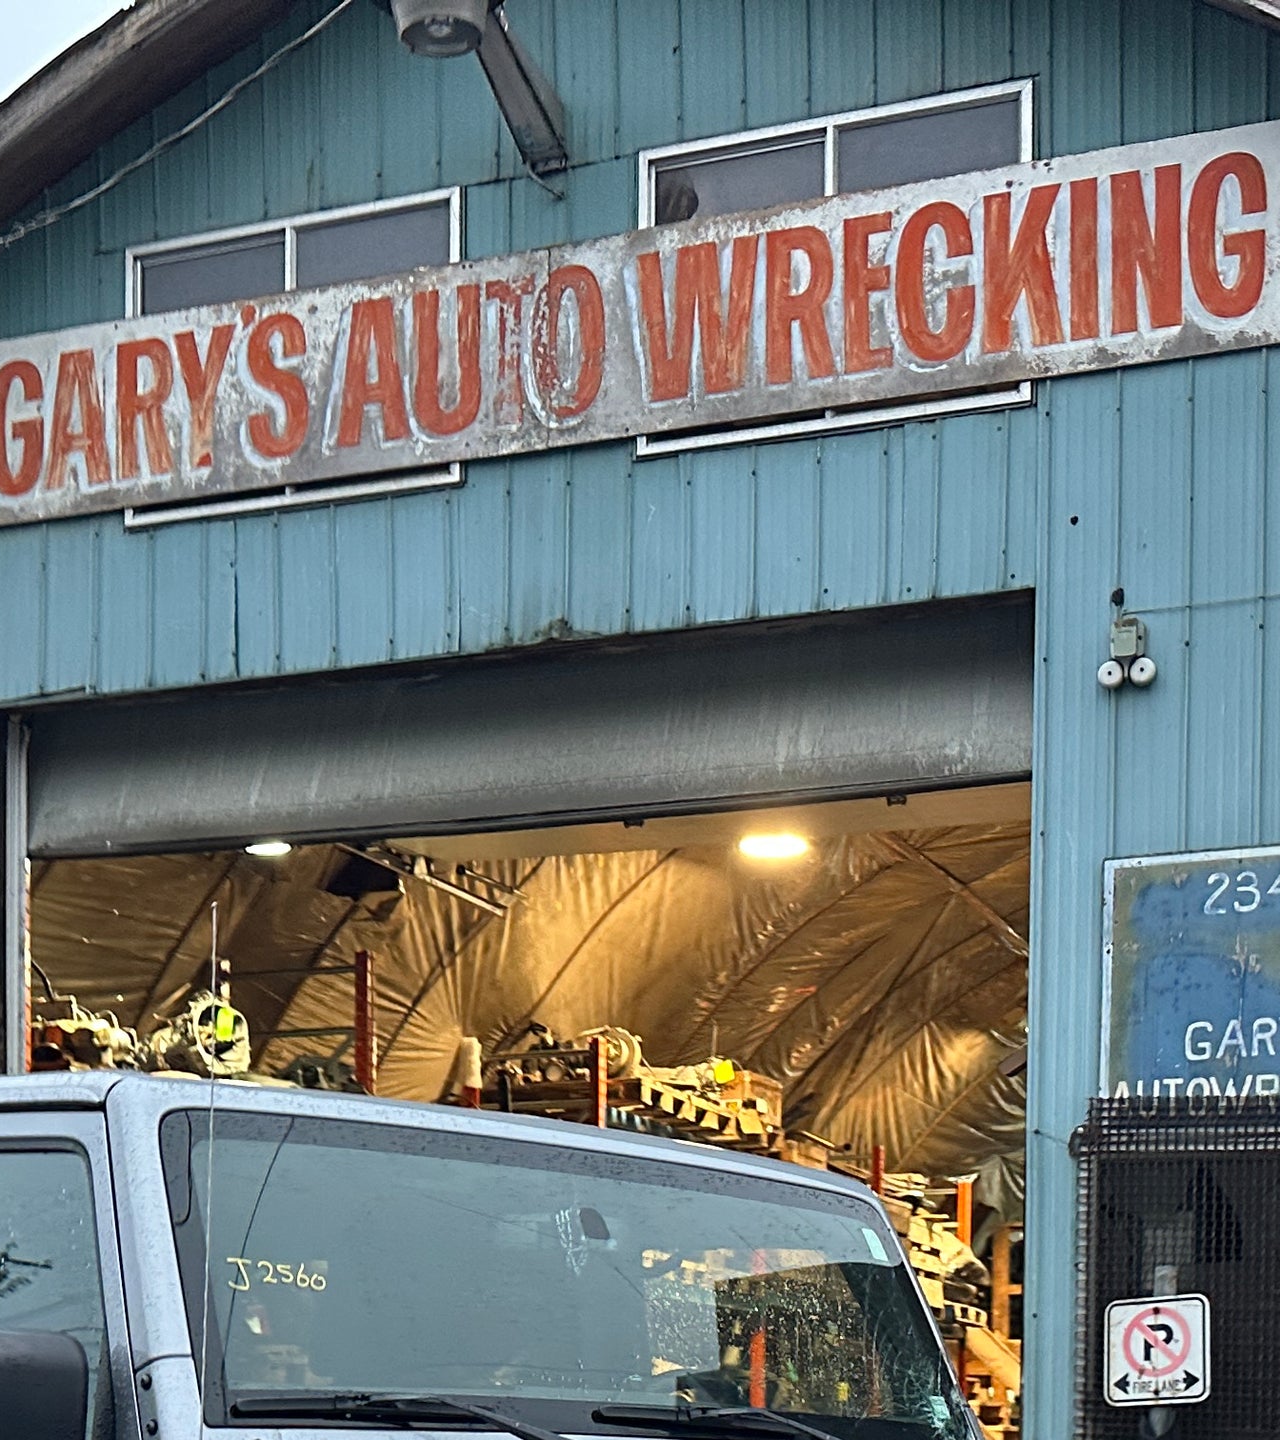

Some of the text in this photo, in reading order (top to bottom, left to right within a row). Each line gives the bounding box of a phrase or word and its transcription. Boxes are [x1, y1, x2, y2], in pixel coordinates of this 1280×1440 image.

[332, 264, 607, 448] AUTO
[636, 150, 1268, 402] WRECKING
[227, 1257, 327, 1291] J2560
